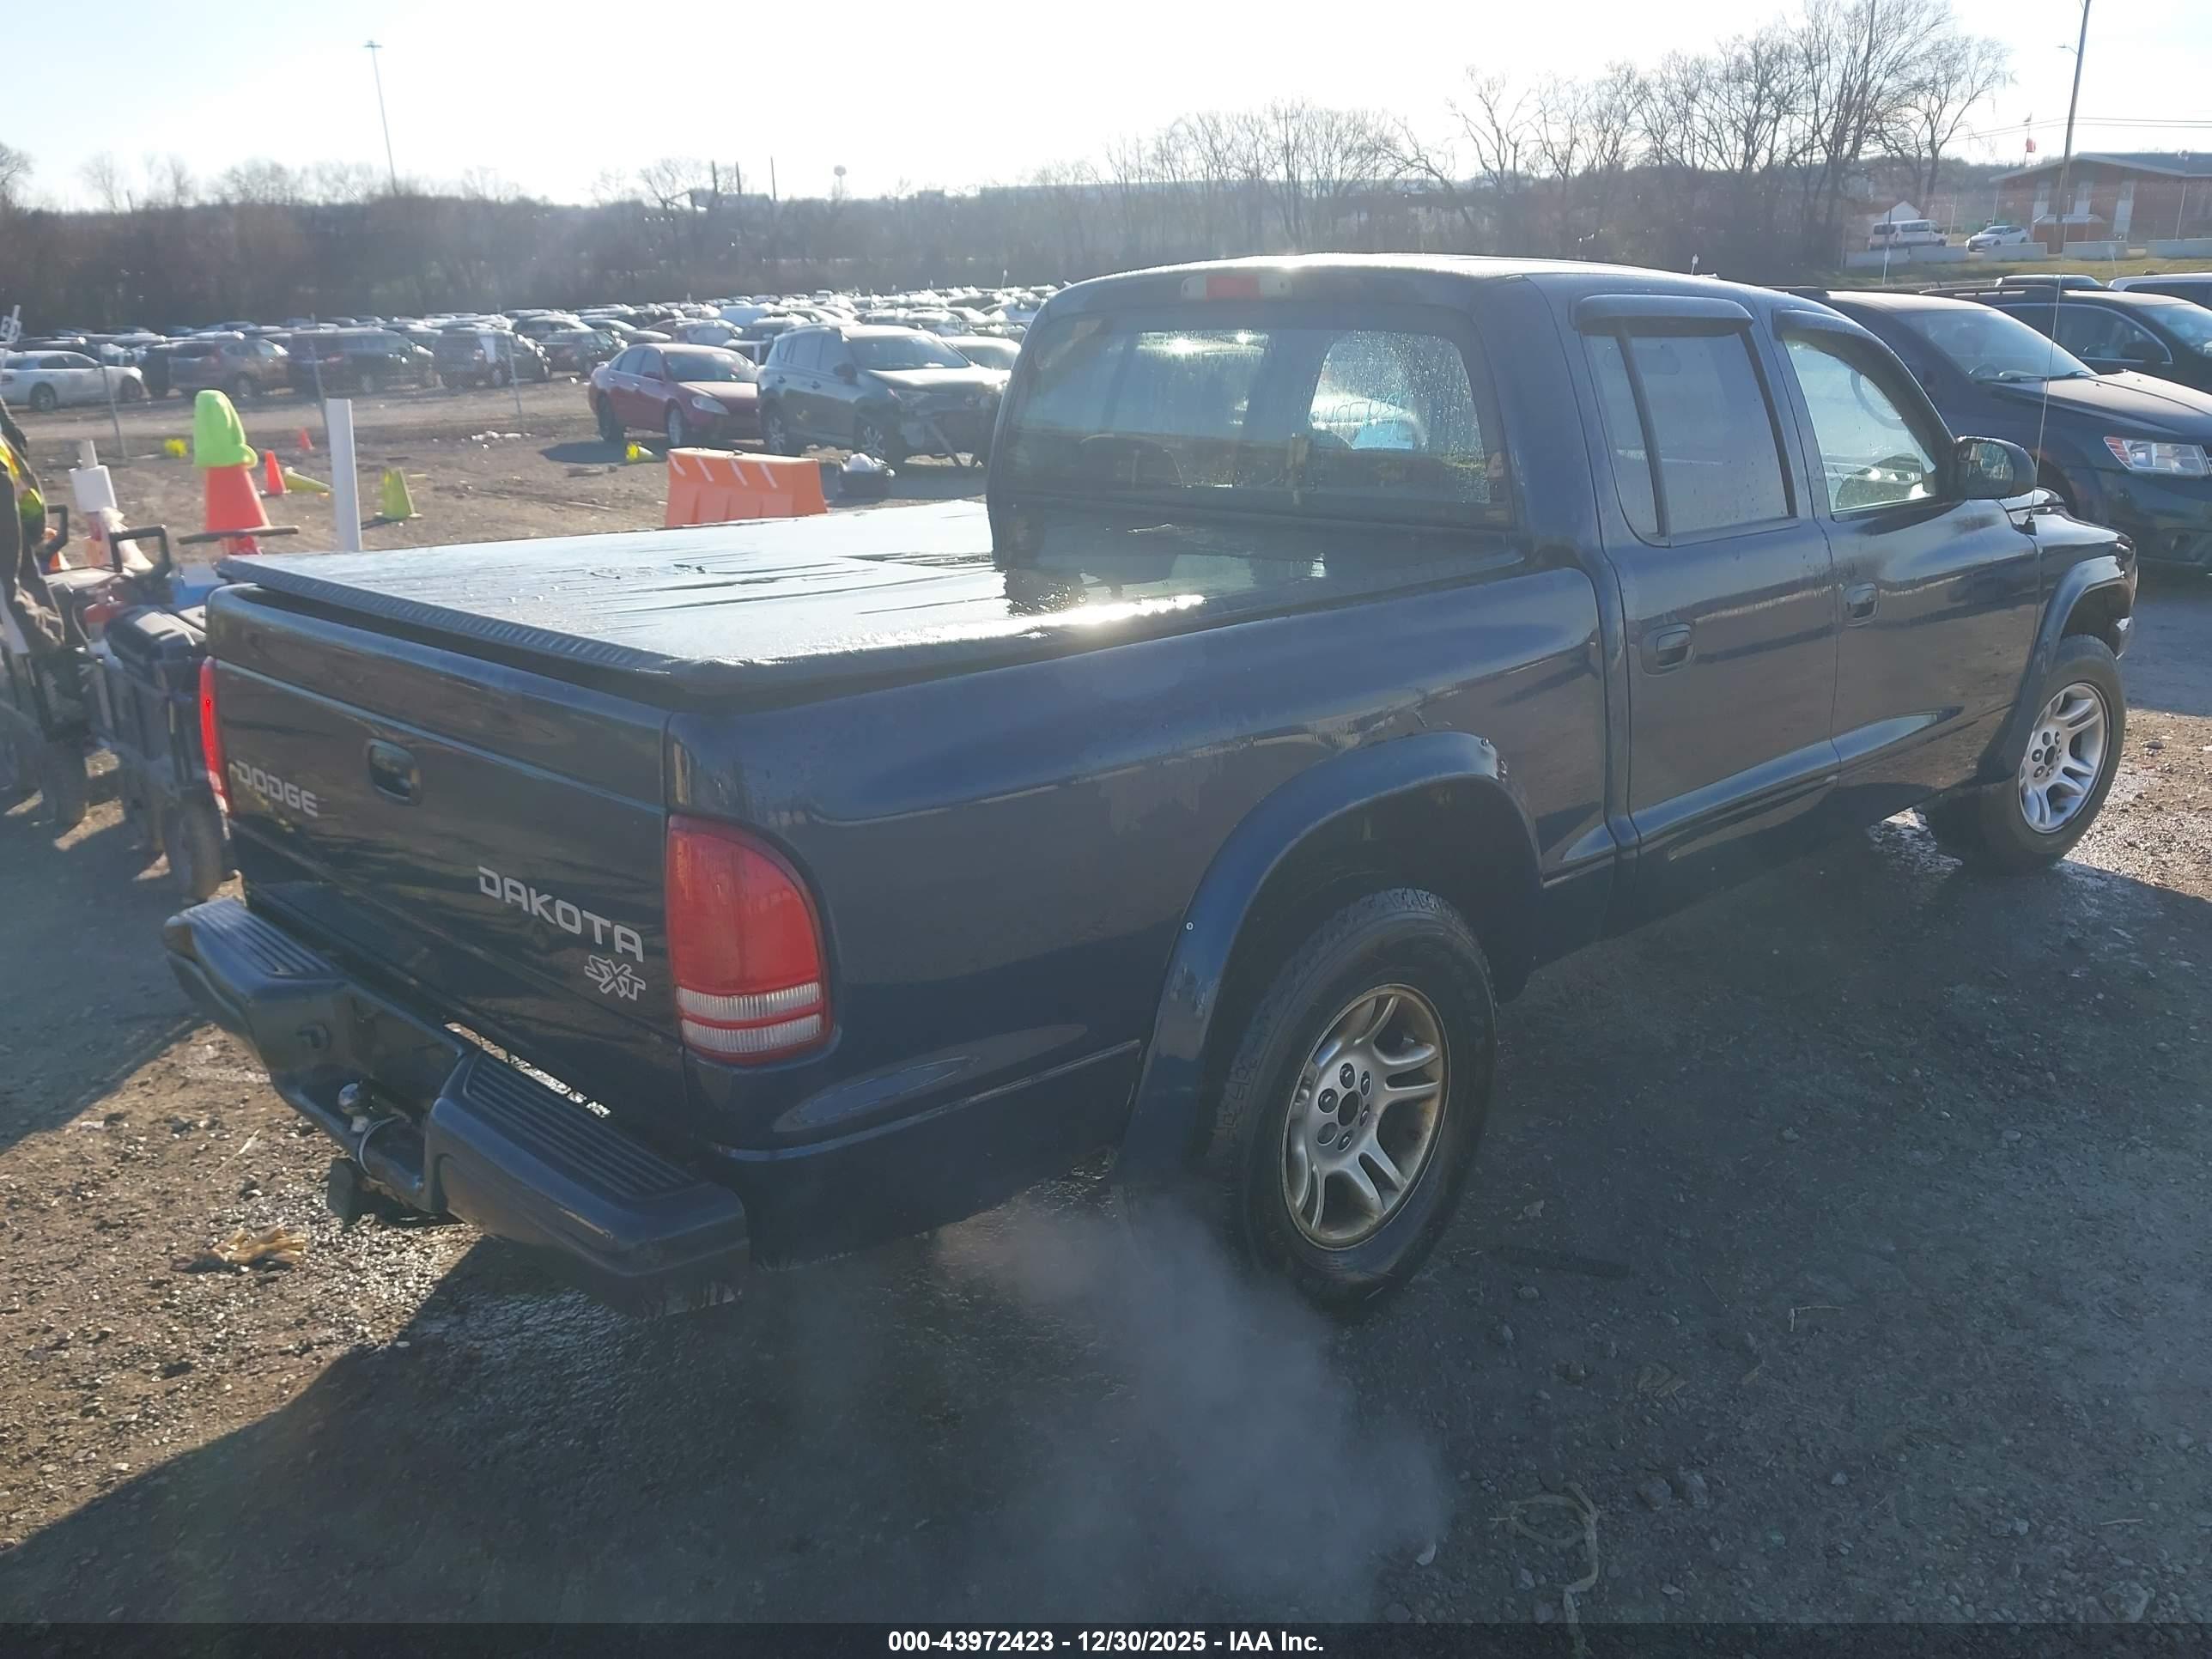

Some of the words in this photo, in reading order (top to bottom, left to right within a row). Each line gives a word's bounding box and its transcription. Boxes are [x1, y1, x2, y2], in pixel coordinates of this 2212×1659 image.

[232, 760, 319, 817] DODGE
[477, 866, 644, 963] DAKOTA
[584, 954, 647, 1001] SXT
